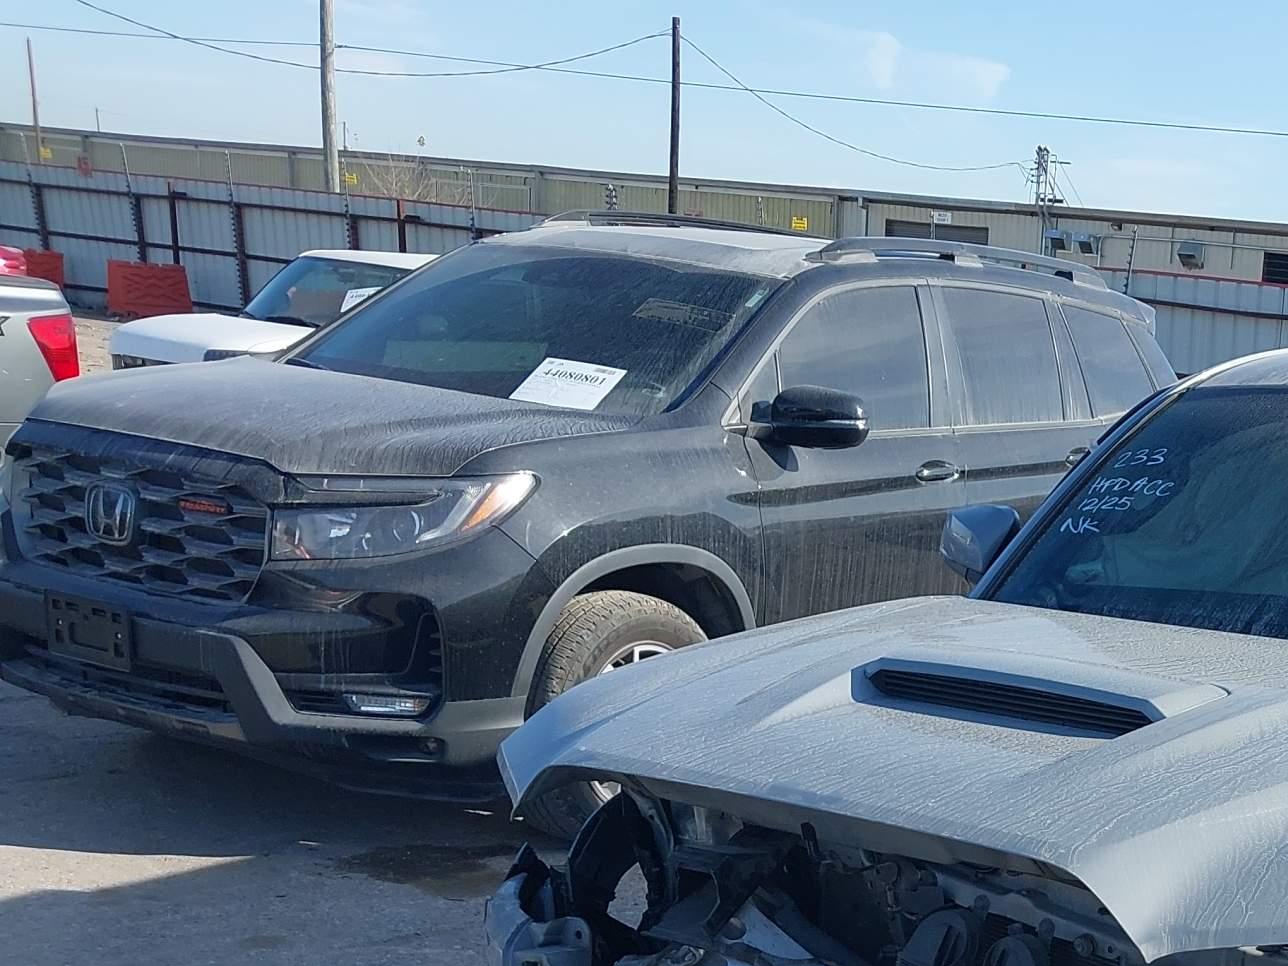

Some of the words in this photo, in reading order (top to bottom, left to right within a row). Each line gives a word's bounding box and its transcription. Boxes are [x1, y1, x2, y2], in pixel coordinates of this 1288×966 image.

[543, 367, 608, 386] 44080801
[1114, 448, 1168, 468] 233
[1078, 495, 1135, 513] 12/25
